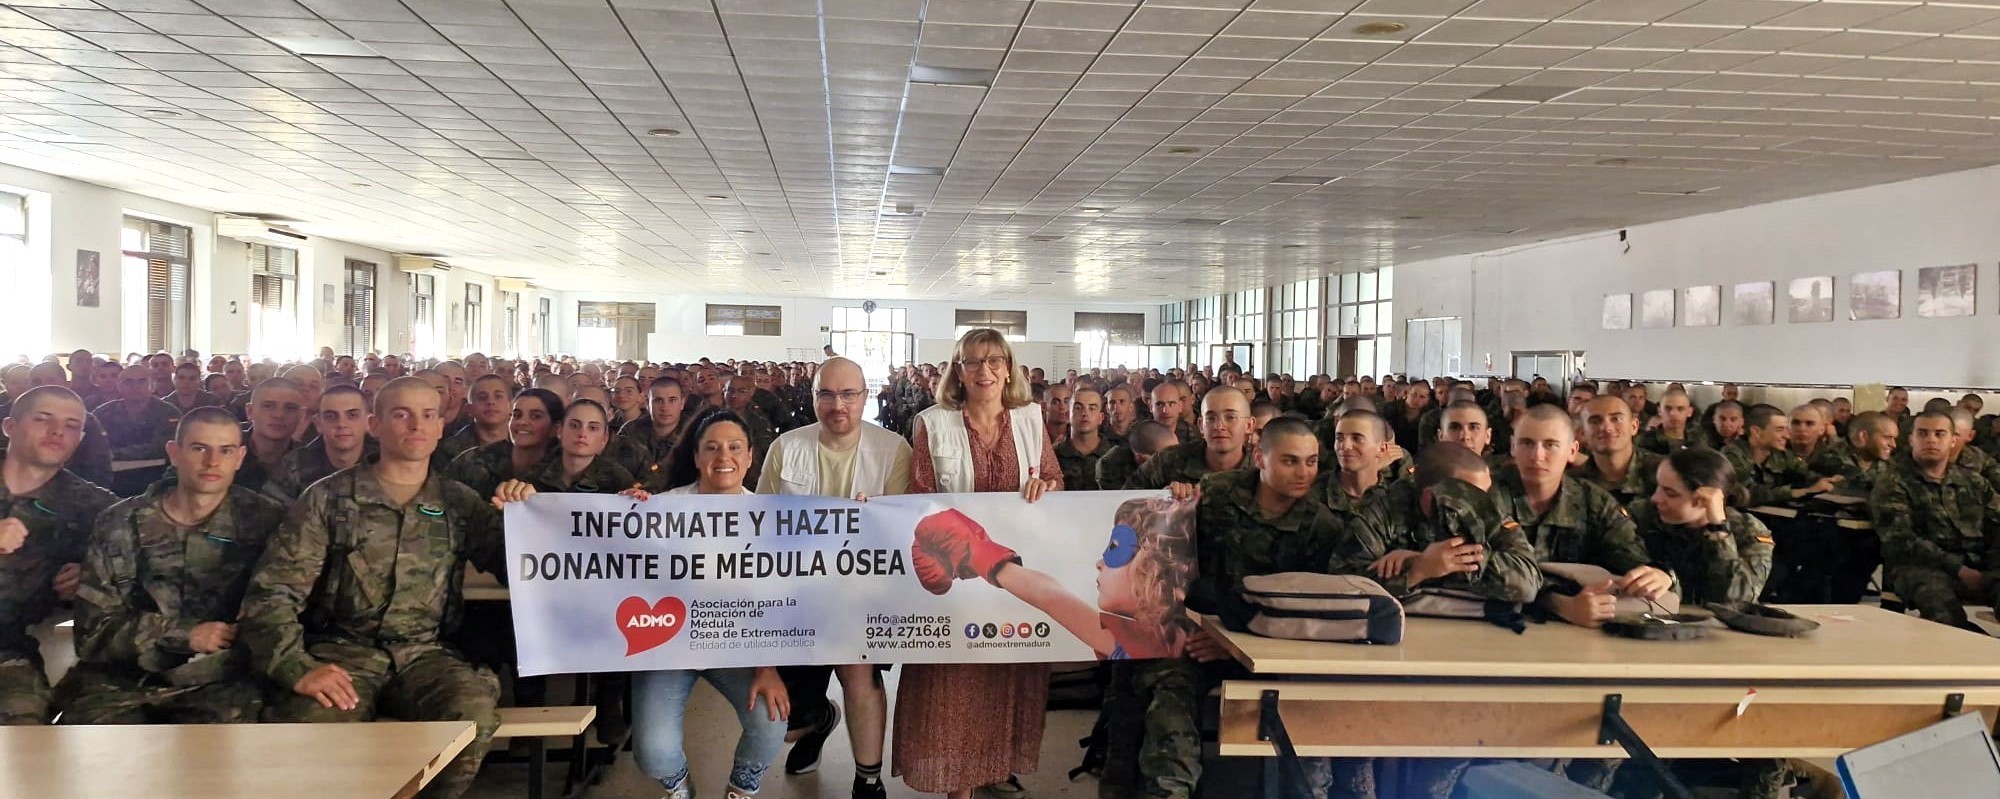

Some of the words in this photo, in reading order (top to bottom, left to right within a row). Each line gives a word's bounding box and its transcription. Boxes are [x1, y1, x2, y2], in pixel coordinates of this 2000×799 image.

[570, 503, 739, 539] INFÓRMATE
[748, 510, 765, 537] Y
[775, 507, 861, 536] HAZTE
[519, 553, 659, 581] DONANTE
[669, 553, 705, 580] DE
[716, 543, 827, 580] MÉDULA
[836, 540, 906, 577] ÓSEA
[690, 599, 755, 609] Asociación
[757, 599, 784, 610] para
[786, 597, 797, 607] la
[690, 608, 746, 619] Donación
[748, 608, 765, 618] de
[865, 613, 951, 625] info@admo.es
[626, 613, 676, 628] ADMO
[690, 618, 735, 629] Médula
[689, 629, 720, 640] Osea
[722, 628, 738, 639] de
[741, 626, 816, 638] Extremadura
[865, 625, 893, 638] 924
[899, 624, 951, 638] 271646
[689, 640, 726, 651] Entidad
[728, 640, 742, 650] de
[743, 639, 778, 649] utilidad
[866, 638, 952, 650] www.admo.es
[966, 641, 1051, 650] @admoextremadura
